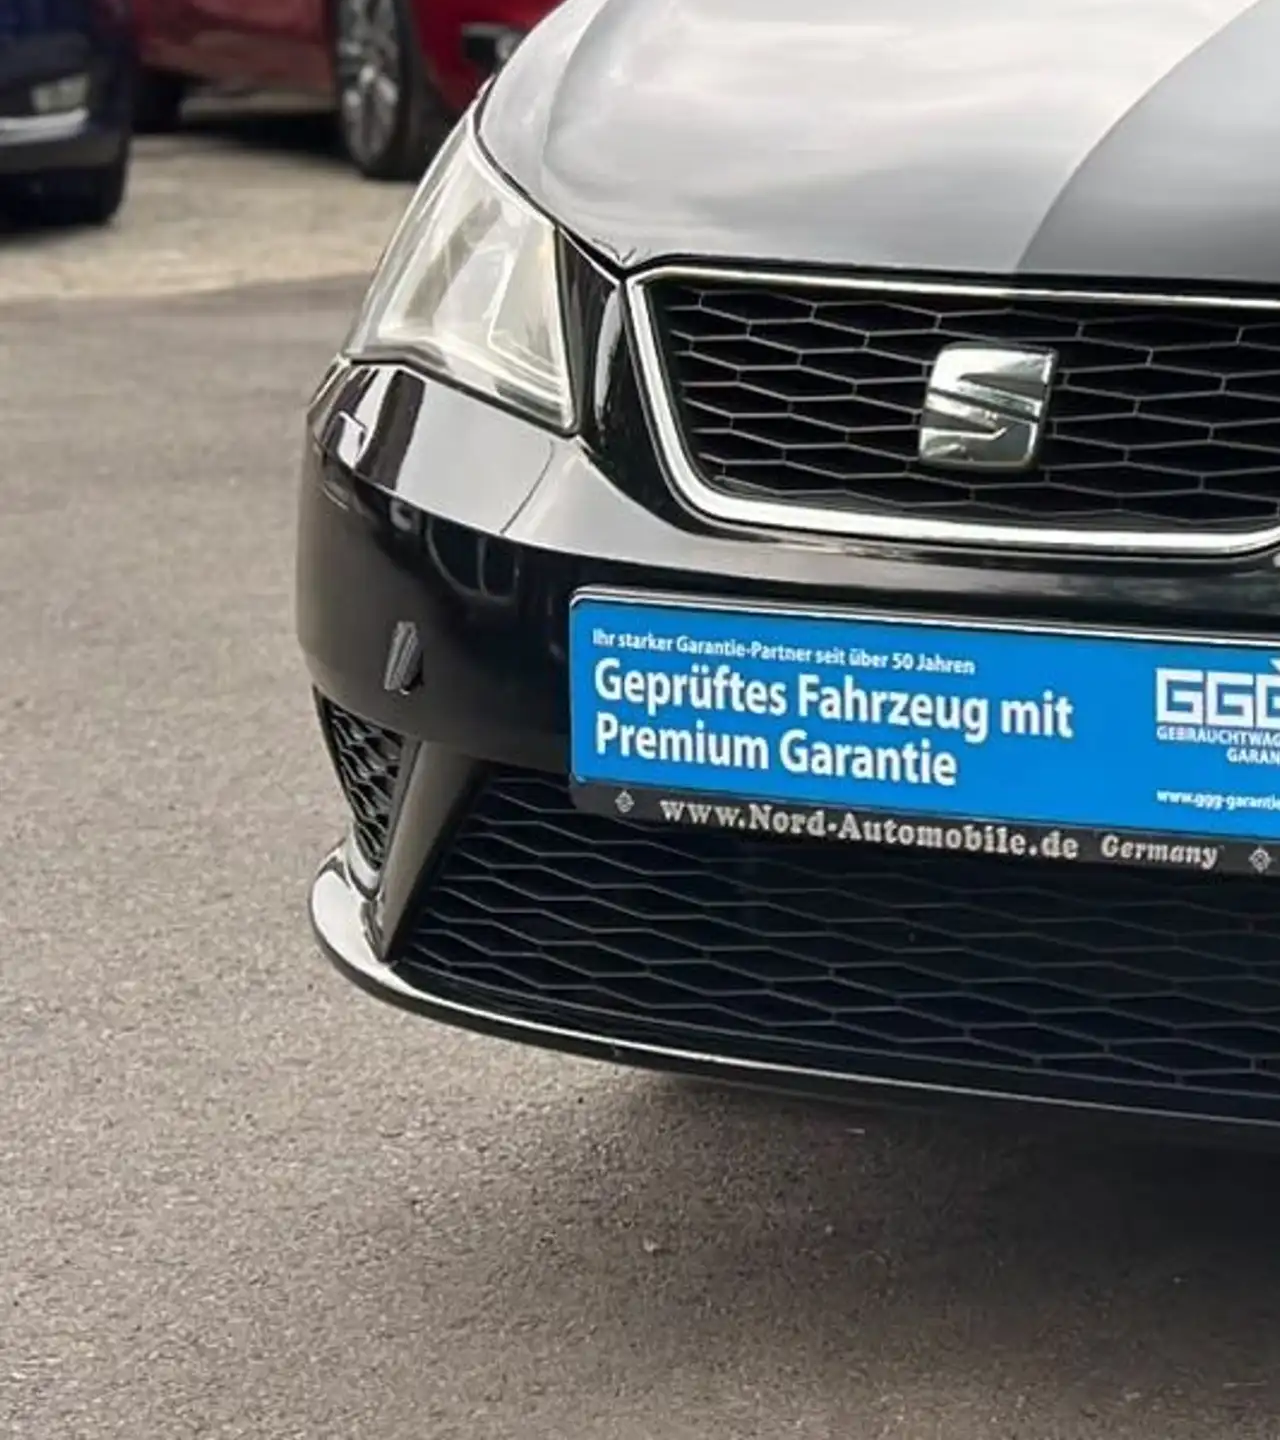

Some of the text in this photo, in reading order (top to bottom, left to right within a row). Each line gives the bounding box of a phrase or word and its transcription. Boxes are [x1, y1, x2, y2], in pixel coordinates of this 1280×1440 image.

[592, 627, 976, 675] Ihr starker Garantie-Partner seit über 50 Jahren
[594, 656, 1074, 744] Geprüftes Fahrzeug mit
[595, 711, 959, 786] Premium Garantie
[659, 799, 1220, 870] www.Nord-Automobile.de Germany
